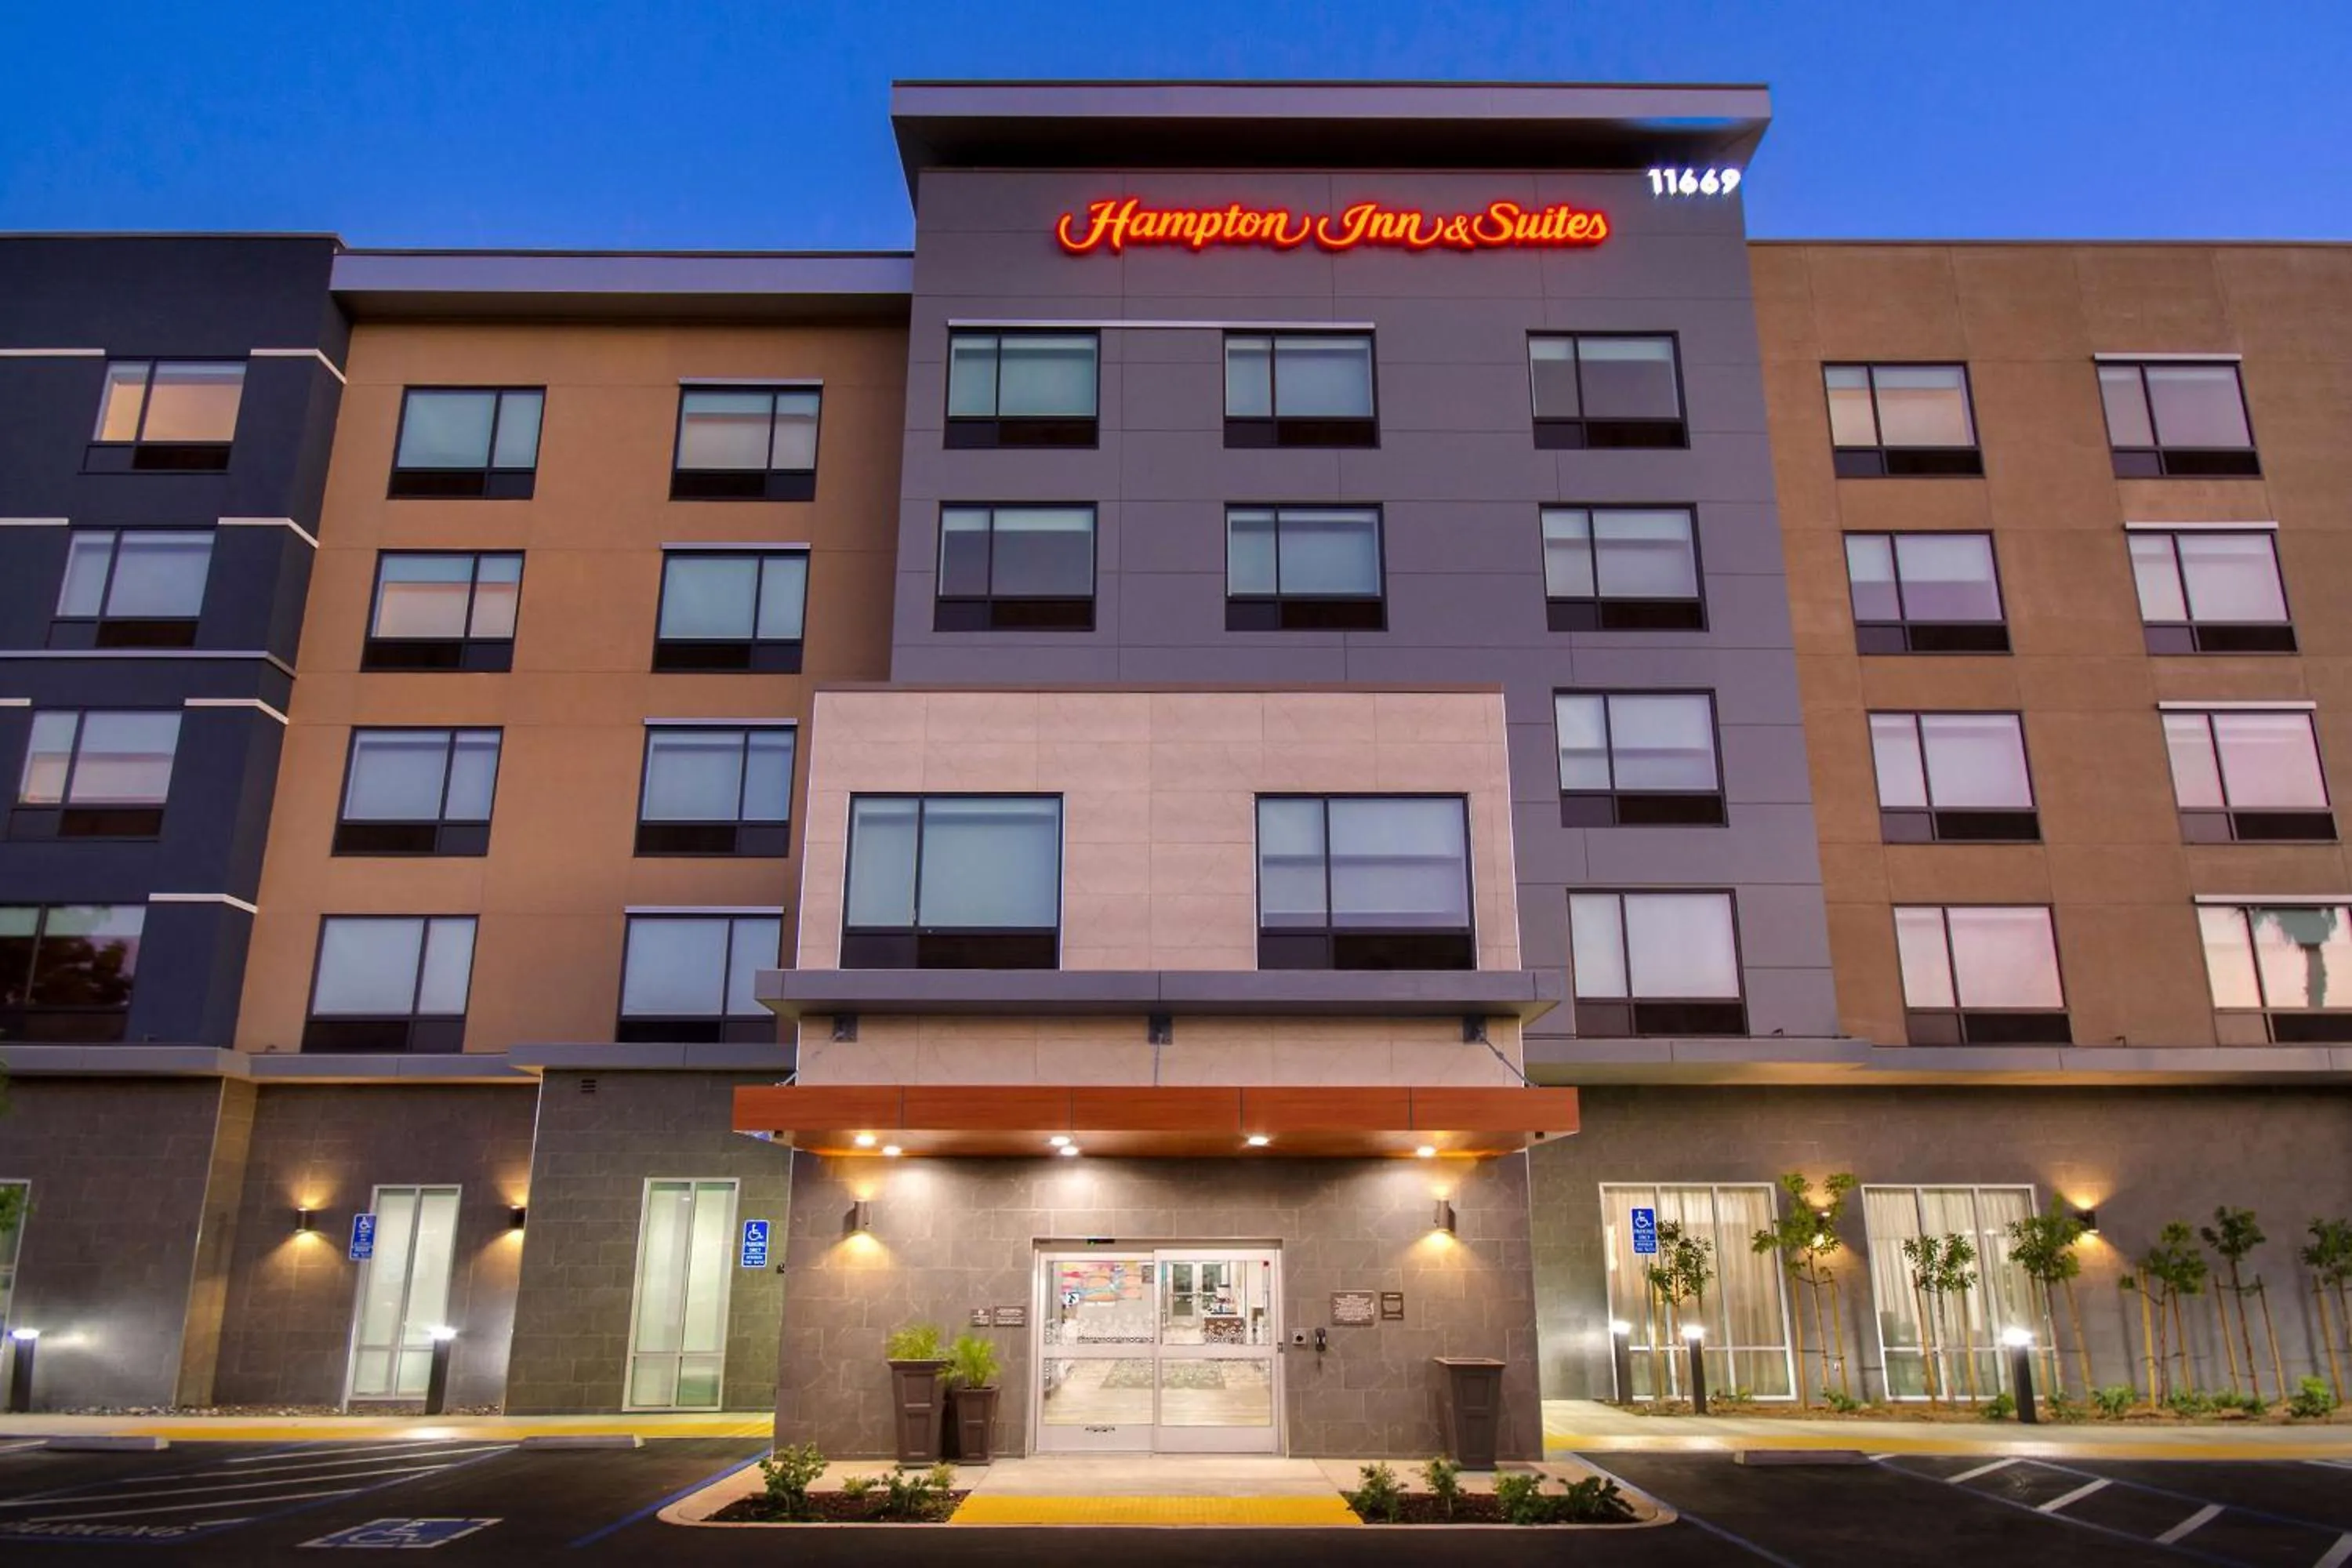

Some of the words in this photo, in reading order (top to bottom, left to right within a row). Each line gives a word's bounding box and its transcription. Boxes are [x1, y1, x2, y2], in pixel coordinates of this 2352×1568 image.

[1647, 168, 1740, 195] 11669
[1058, 198, 1312, 251] Hampton
[1316, 202, 1444, 249] Inn
[1443, 215, 1475, 247] &
[1472, 201, 1608, 245] Suites
